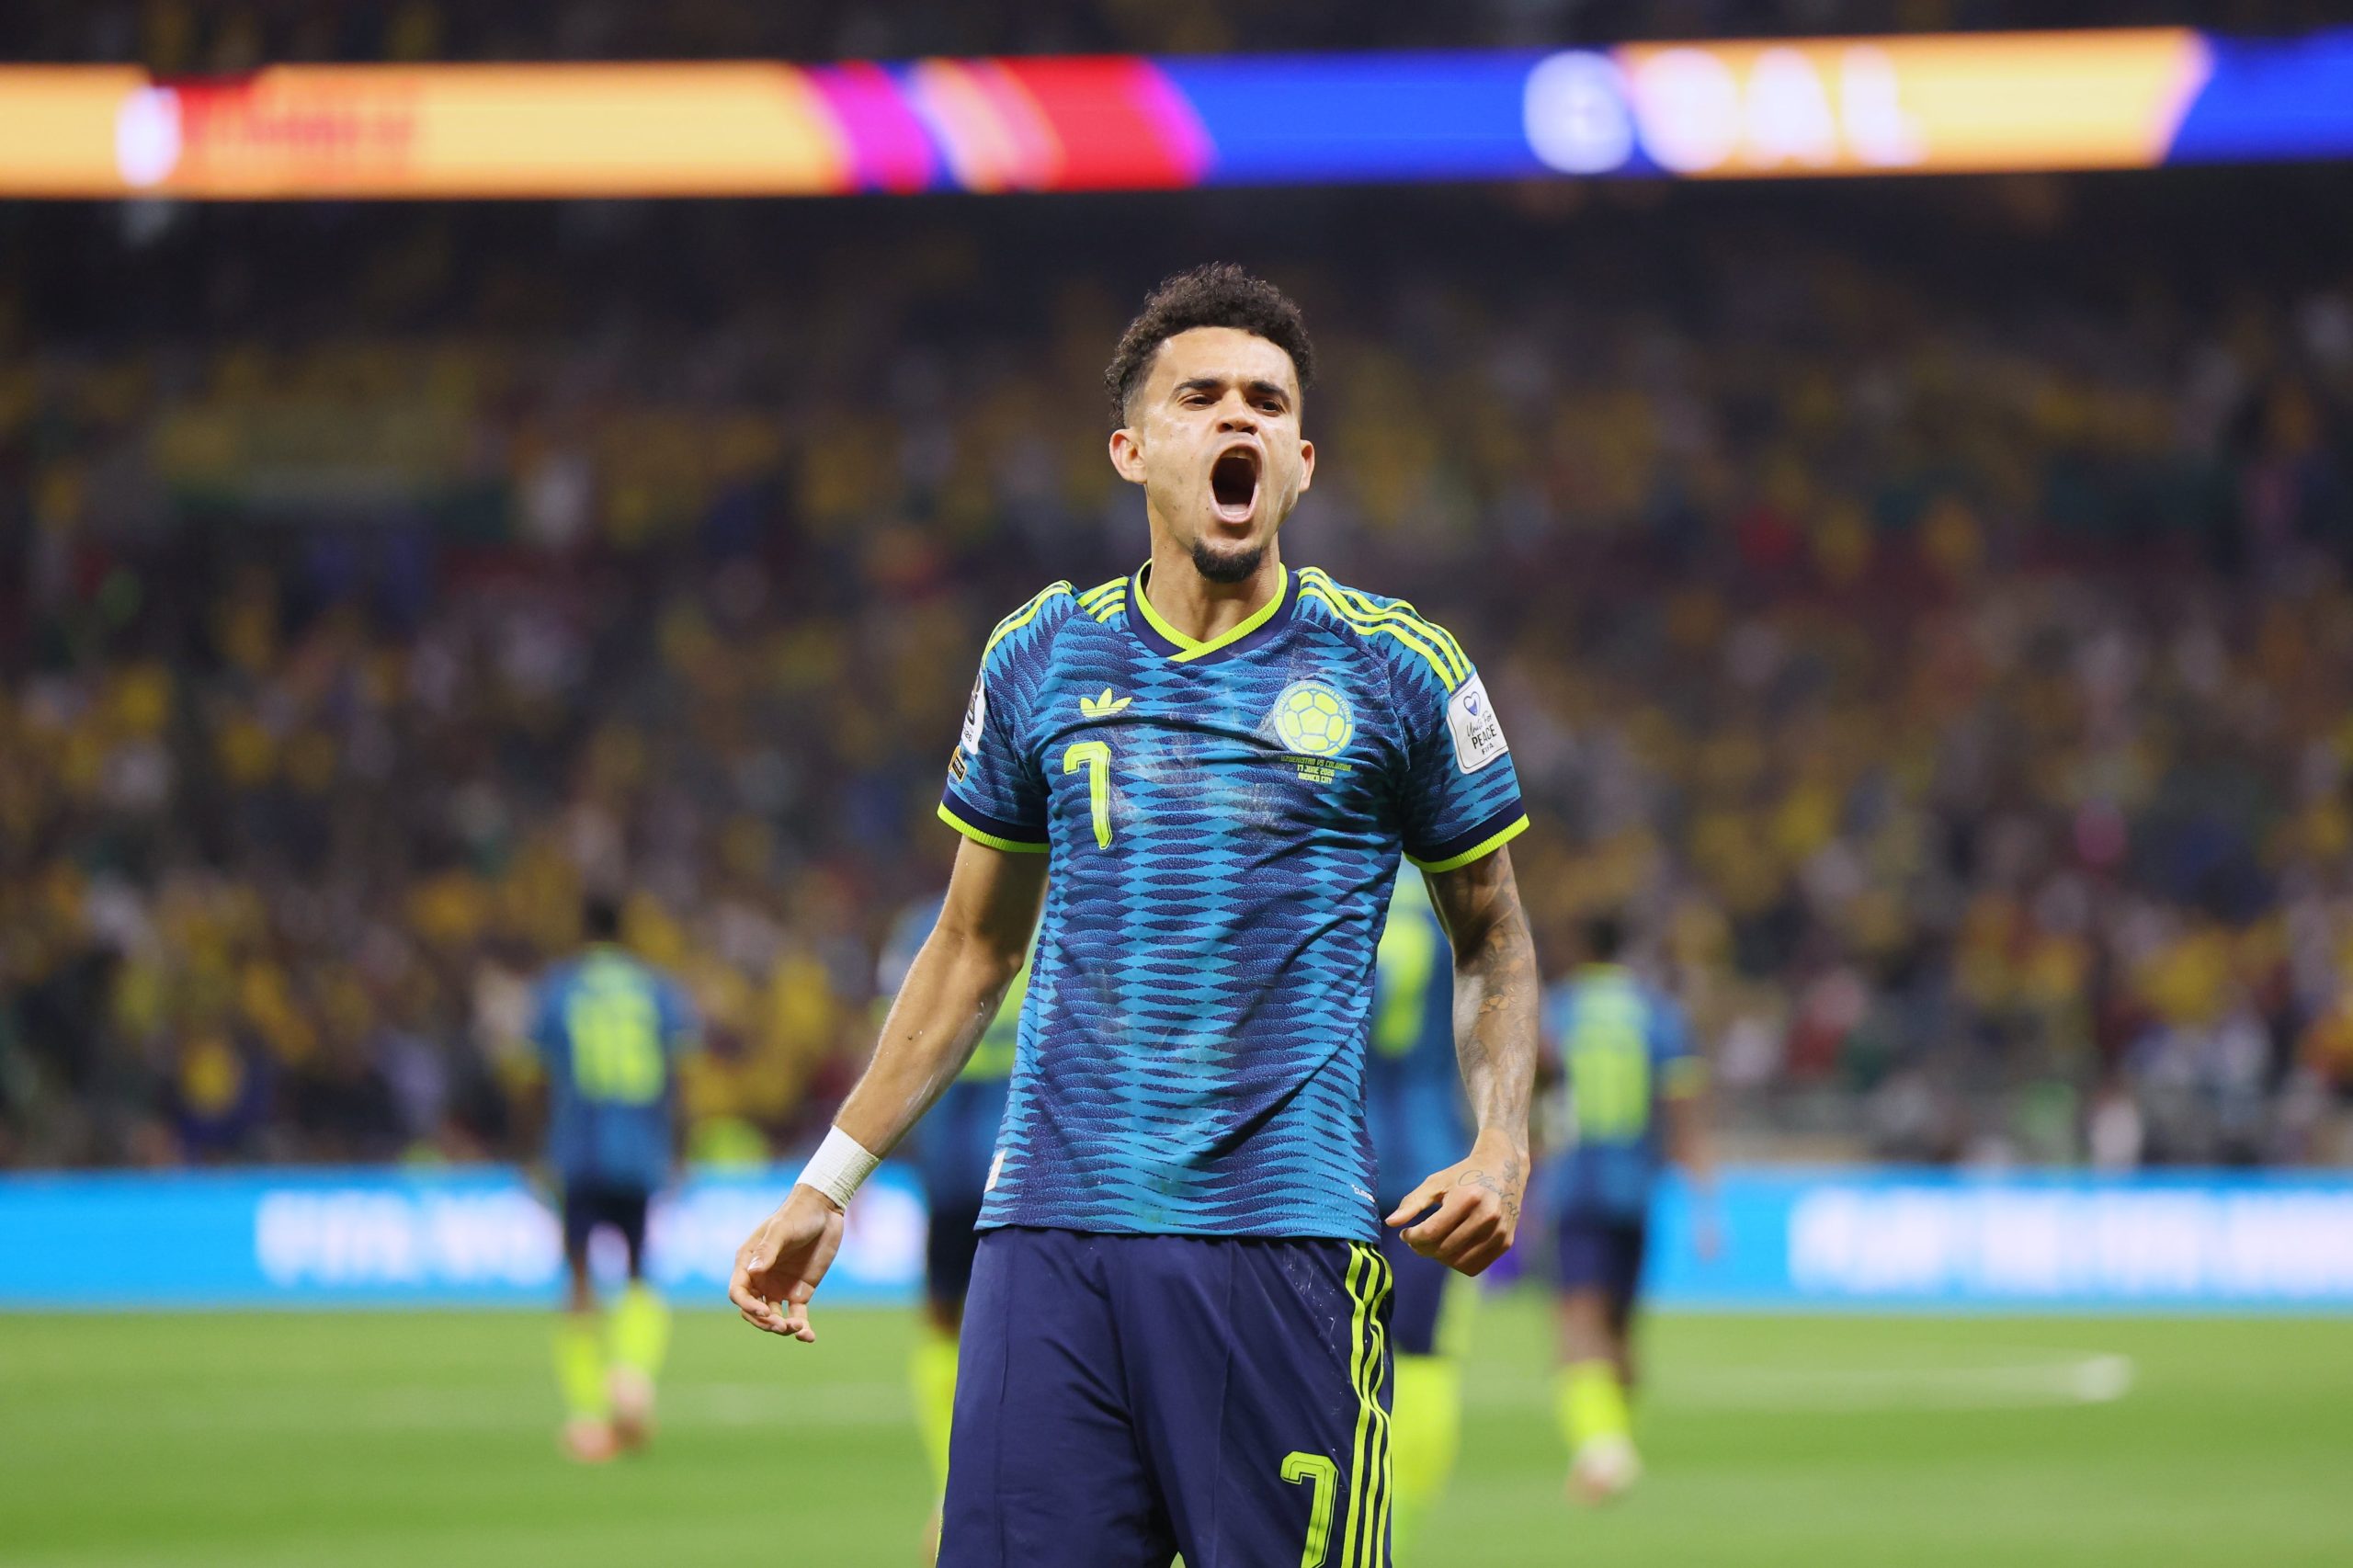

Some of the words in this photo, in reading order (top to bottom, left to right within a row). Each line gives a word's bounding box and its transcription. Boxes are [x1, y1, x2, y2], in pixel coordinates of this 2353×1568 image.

[1472, 724, 1496, 749] PEACE
[1063, 741, 1112, 850] 7
[1280, 1451, 1338, 1568] 7
